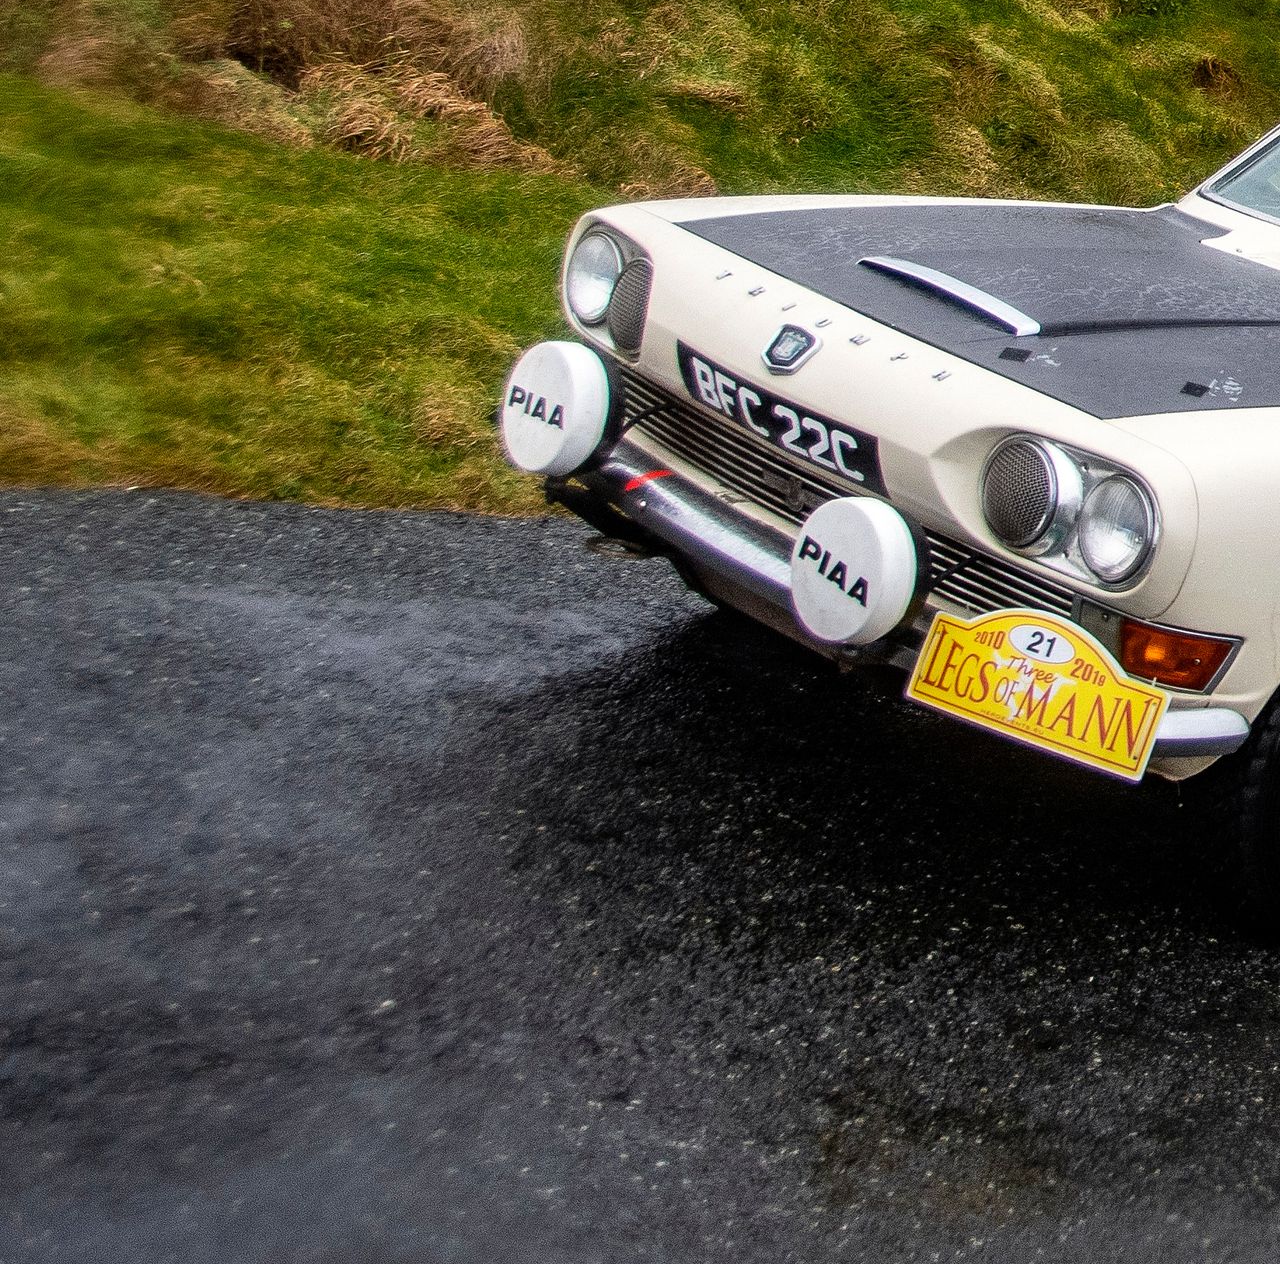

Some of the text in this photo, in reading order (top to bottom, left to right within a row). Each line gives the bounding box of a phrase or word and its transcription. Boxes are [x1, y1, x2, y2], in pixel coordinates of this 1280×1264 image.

[716, 269, 952, 382] TRIUMPH
[508, 385, 565, 431] PIAA
[692, 356, 865, 482] BFC 22C
[799, 535, 871, 608] PIAA
[921, 624, 1156, 760] LEGS OF MANN
[974, 630, 1107, 687] 2010 21 2019
[1006, 655, 1058, 684] Three
